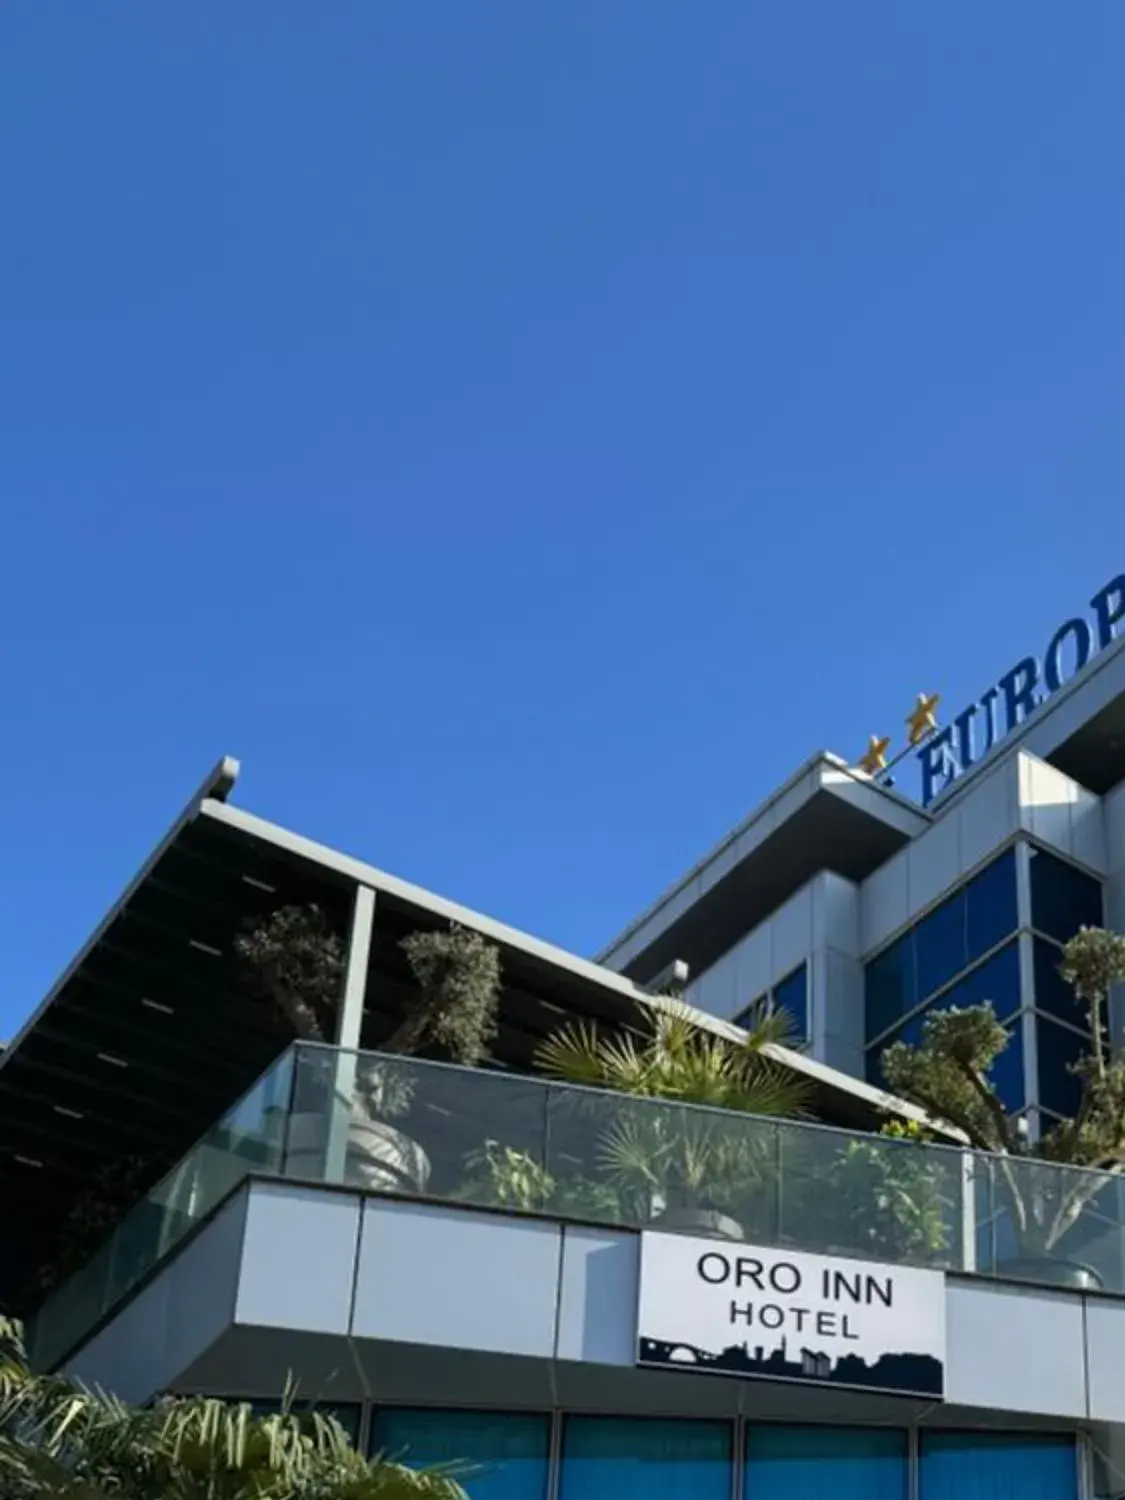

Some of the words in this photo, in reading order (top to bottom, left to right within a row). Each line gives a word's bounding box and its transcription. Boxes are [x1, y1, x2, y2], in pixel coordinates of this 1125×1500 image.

[697, 1252, 801, 1293] ORO
[823, 1269, 893, 1307] INN
[730, 1301, 860, 1339] HOTEL
